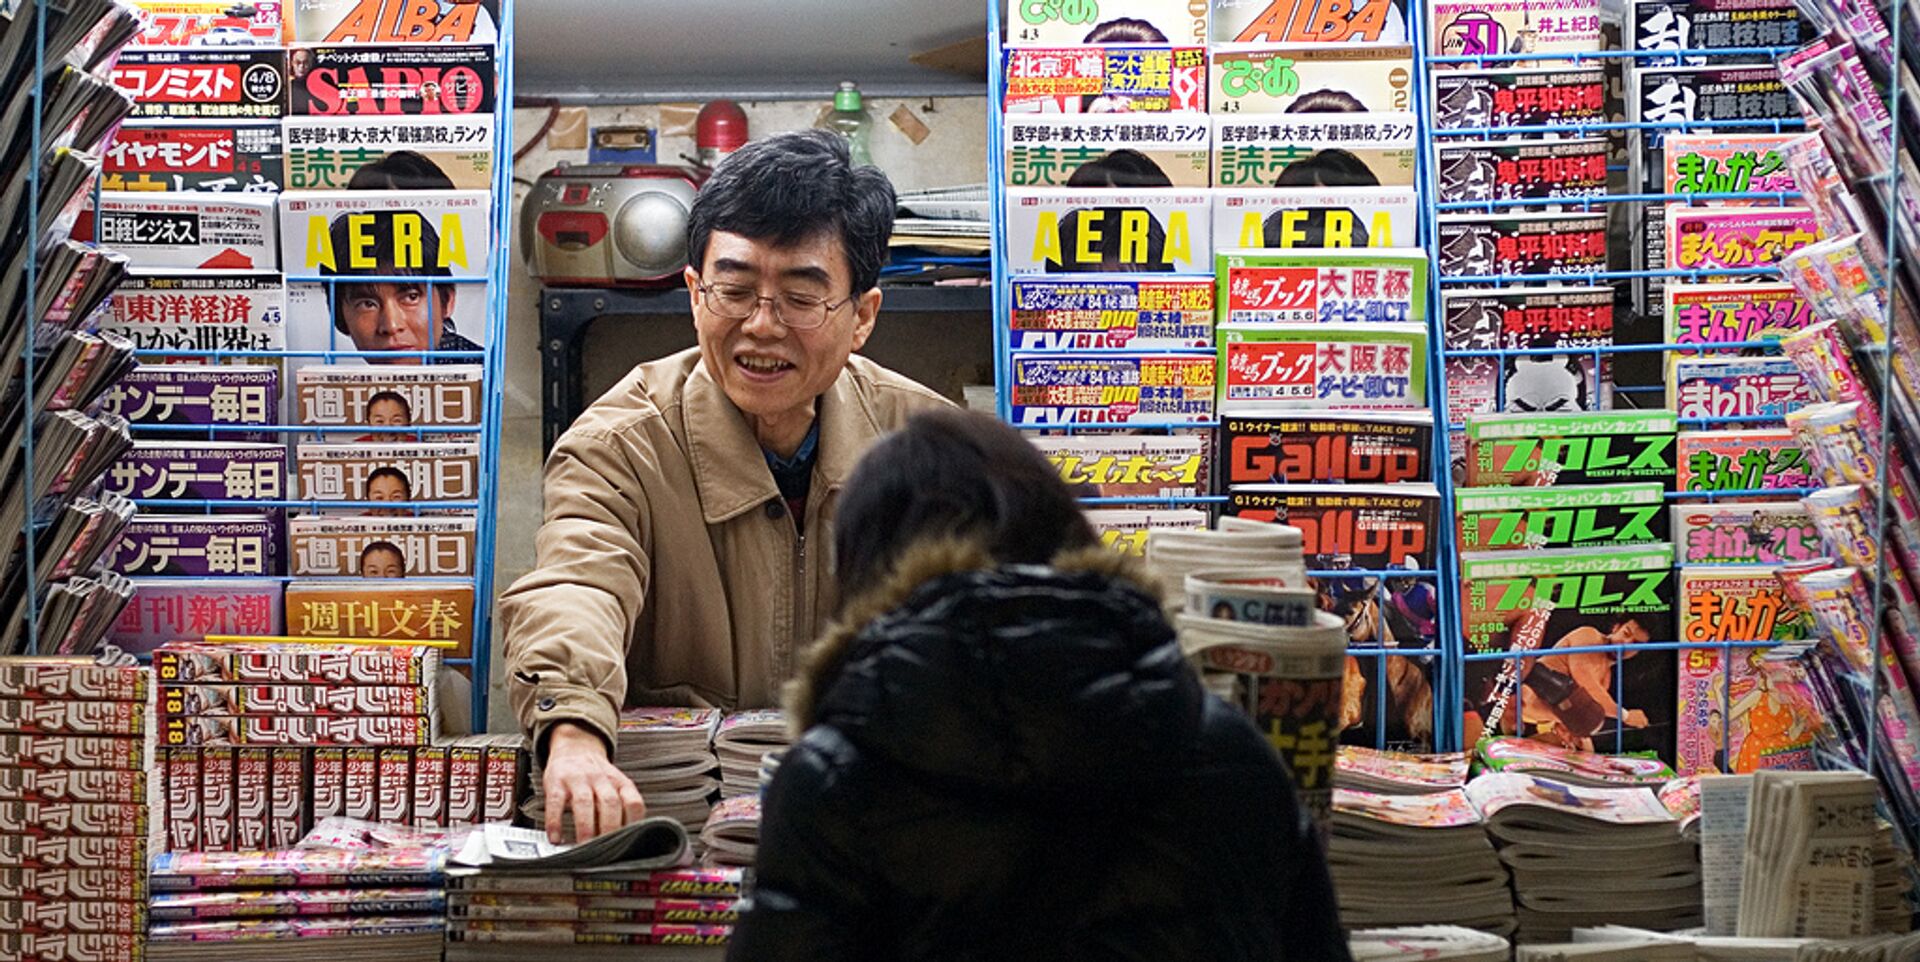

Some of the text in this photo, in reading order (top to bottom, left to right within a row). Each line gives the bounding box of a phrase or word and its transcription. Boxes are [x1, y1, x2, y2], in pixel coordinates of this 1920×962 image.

[322, 0, 480, 42] ALBA
[1232, 0, 1391, 42] ALBA
[1538, 15, 1600, 34] 井上紀良
[112, 68, 234, 98] エコノミスト
[249, 71, 276, 83] 4/8
[306, 66, 484, 115] SAPIO
[1220, 56, 1300, 97] ぴあ
[1494, 85, 1604, 114] 鬼平犯科帳
[290, 147, 385, 188] 読売
[1011, 145, 1106, 185] 読売
[1220, 145, 1314, 185] 読売
[1496, 155, 1607, 184] 鬼平犯科帳
[101, 216, 195, 243] 日経ビジネス
[305, 213, 469, 273] AERA
[1031, 210, 1192, 267] AERA
[1238, 210, 1393, 248] AERA
[1496, 231, 1606, 261] 鬼平犯科帳
[1679, 228, 1826, 266] まんがタウ
[1231, 275, 1316, 307] 競馬ブック
[1319, 268, 1411, 300] 大阪杯
[126, 294, 252, 324] 東洋経済
[1099, 311, 1138, 329] DVD
[1319, 299, 1410, 322] ダービー卿CT
[1503, 306, 1613, 334] 鬼平犯科帳
[100, 327, 271, 350] れから世界は
[1230, 351, 1315, 383] 競馬ブック
[1318, 344, 1411, 375] 大阪杯
[1101, 386, 1140, 404] DVD
[1317, 374, 1409, 398] ダービー卿CT
[104, 385, 266, 423] サンデー毎日
[302, 384, 473, 424] 週刊朝日
[1230, 434, 1420, 484] Gallop
[1477, 440, 1494, 472] 週刊
[1493, 435, 1677, 472] プロレス
[111, 461, 280, 498] サンデー毎日
[302, 459, 472, 500] 週刊朝日
[1586, 469, 1616, 477] WEEKLY
[1238, 510, 1426, 564] allop
[1462, 513, 1479, 546] 週刊
[1479, 505, 1662, 546] プロレス
[295, 534, 467, 574] 週刊朝日
[1470, 580, 1486, 611] 週刊
[1487, 571, 1670, 611] プロレス
[115, 592, 272, 635] 週刊新潮
[299, 598, 463, 638] 週刊文春
[1579, 606, 1609, 615] WEEKLY
[161, 655, 176, 679] 18
[166, 691, 184, 713] 18
[168, 721, 184, 743] 18
[169, 776, 197, 851] ジャ
[203, 775, 231, 851] ジャ
